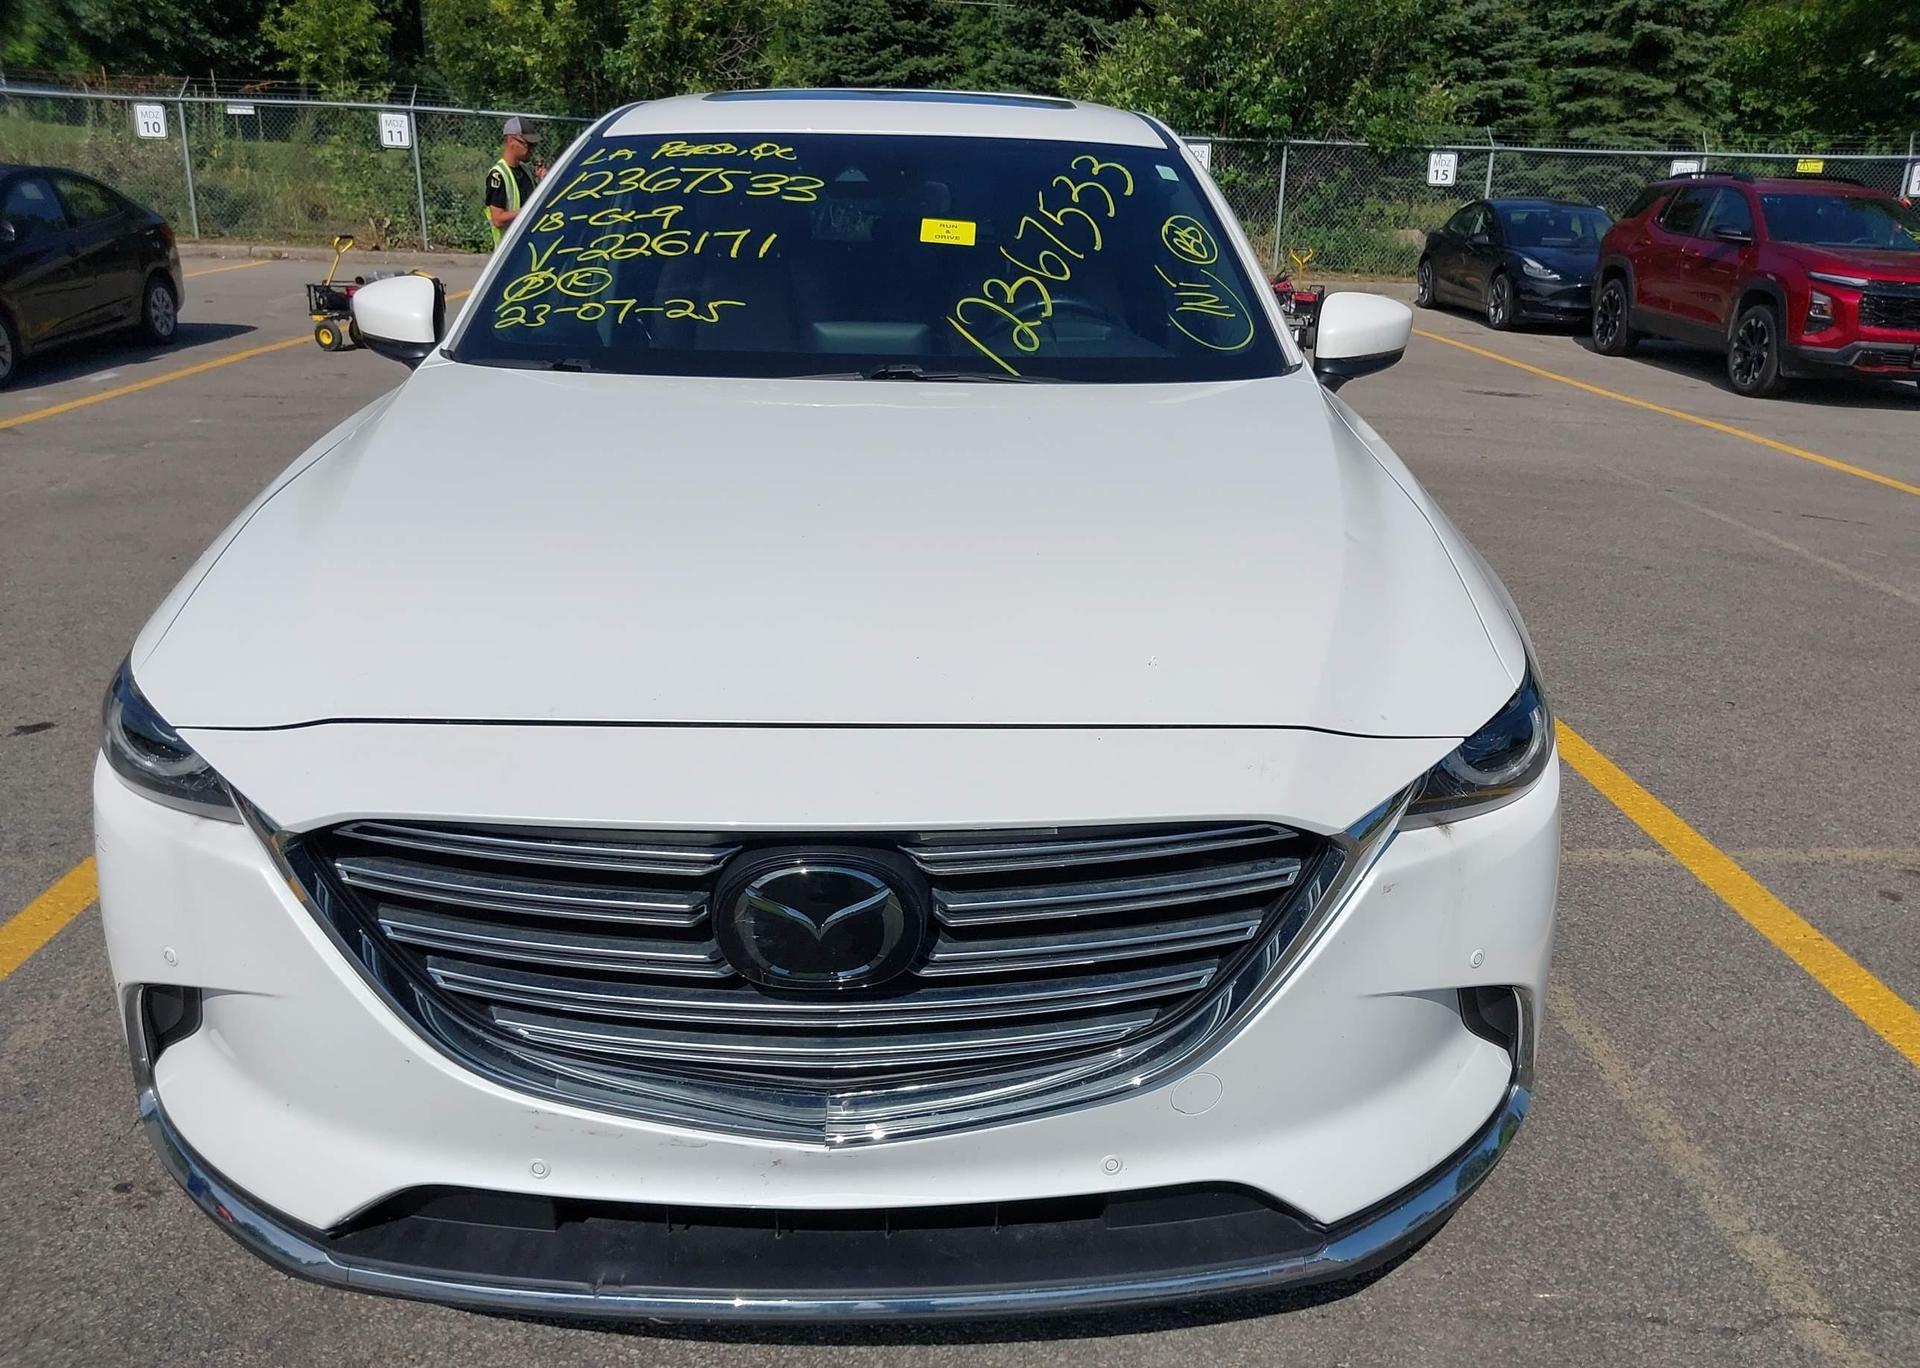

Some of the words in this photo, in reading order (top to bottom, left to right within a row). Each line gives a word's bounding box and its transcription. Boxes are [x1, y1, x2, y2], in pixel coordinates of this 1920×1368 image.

[140, 110, 160, 120] MDZ
[143, 121, 161, 135] 10
[384, 119, 405, 128] MDZ
[387, 130, 404, 143] 11
[1433, 159, 1452, 168] MDZ
[1434, 169, 1449, 181] 15
[546, 166, 826, 208] 12367533
[945, 155, 1135, 377] 12367533
[494, 298, 747, 330] 23-07-25
